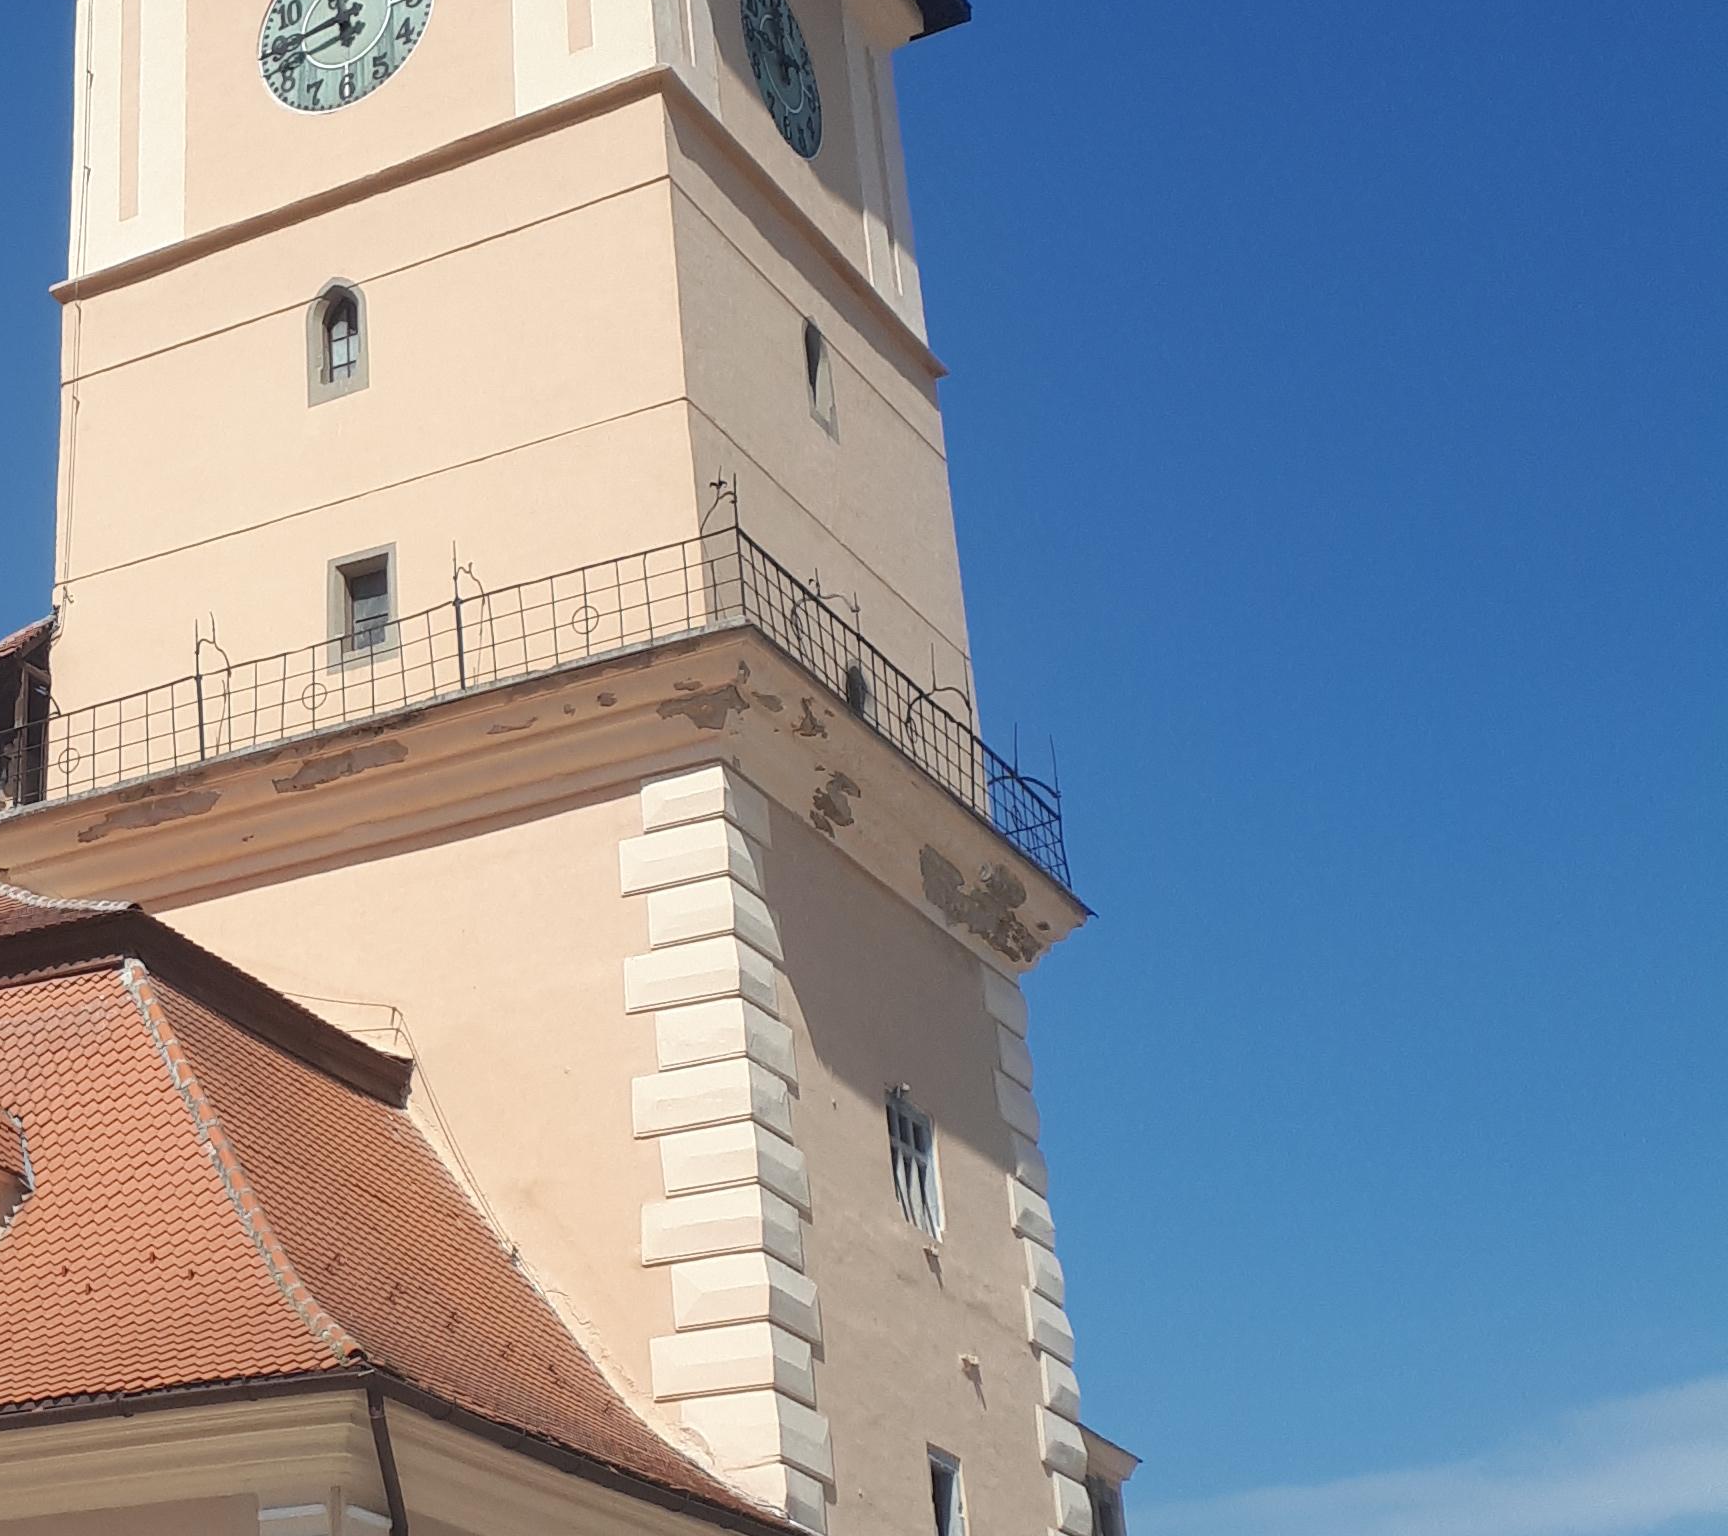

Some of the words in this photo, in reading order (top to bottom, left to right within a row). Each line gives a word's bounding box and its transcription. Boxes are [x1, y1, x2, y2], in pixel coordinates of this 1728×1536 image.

[276, 0, 303, 31] 10
[395, 16, 416, 46] 4
[372, 52, 390, 80] 5
[306, 78, 325, 106] 7
[338, 72, 356, 101] 6
